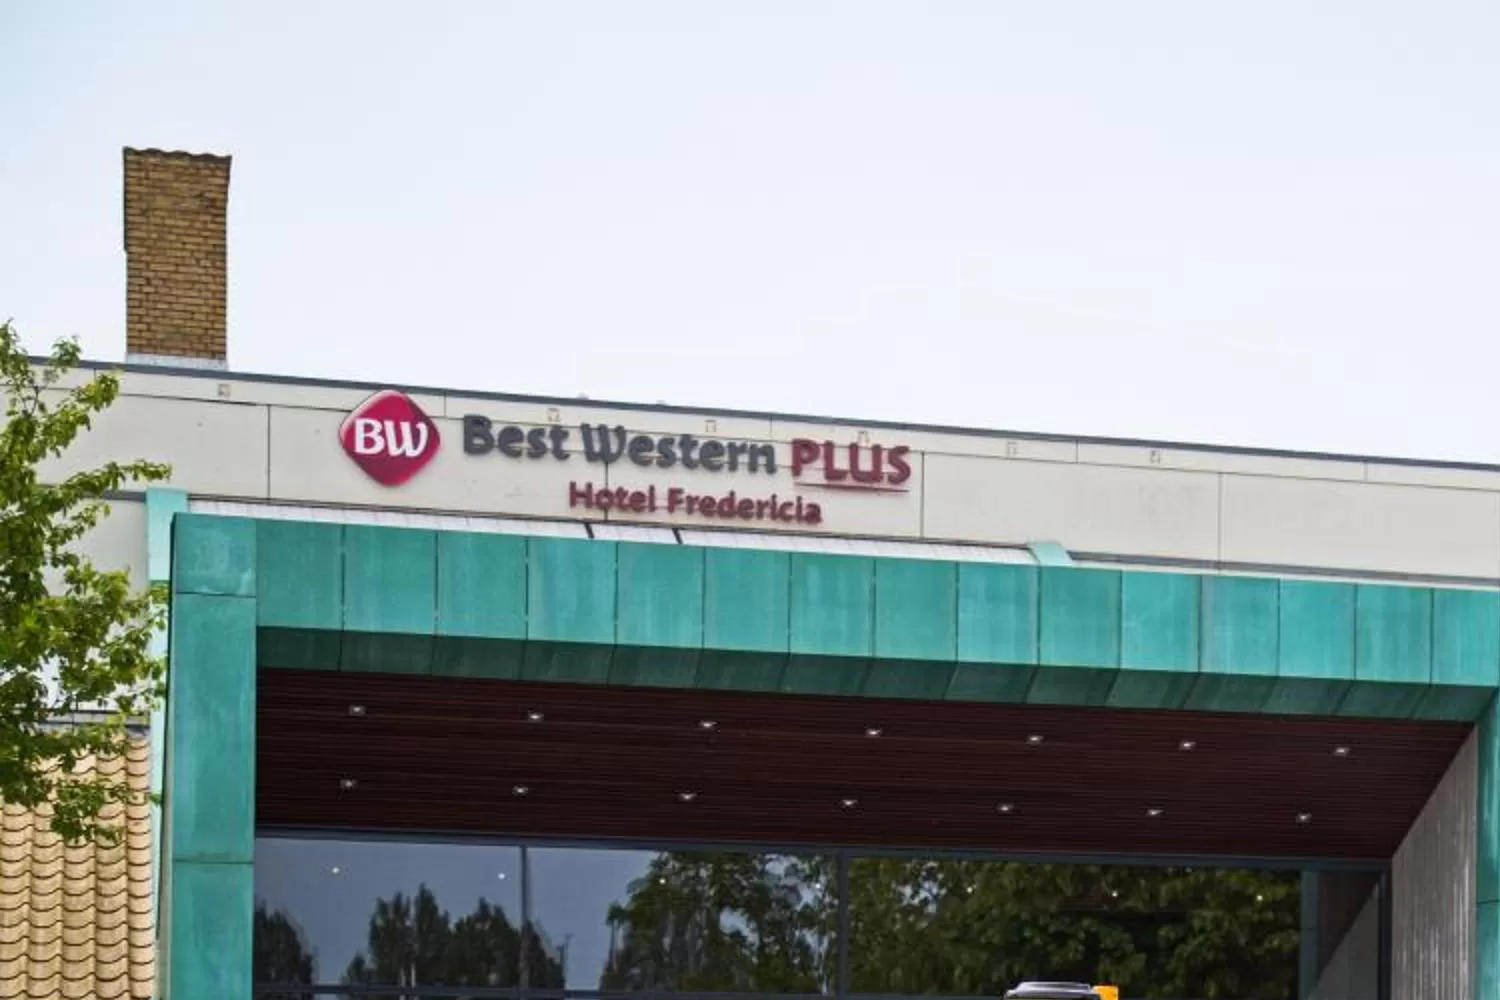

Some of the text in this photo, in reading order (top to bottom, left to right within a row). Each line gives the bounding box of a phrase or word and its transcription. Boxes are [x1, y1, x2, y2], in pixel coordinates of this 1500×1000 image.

[354, 418, 428, 457] BW
[463, 414, 912, 485] Best Western PLUS
[569, 481, 822, 524] Hotel Fredericia
